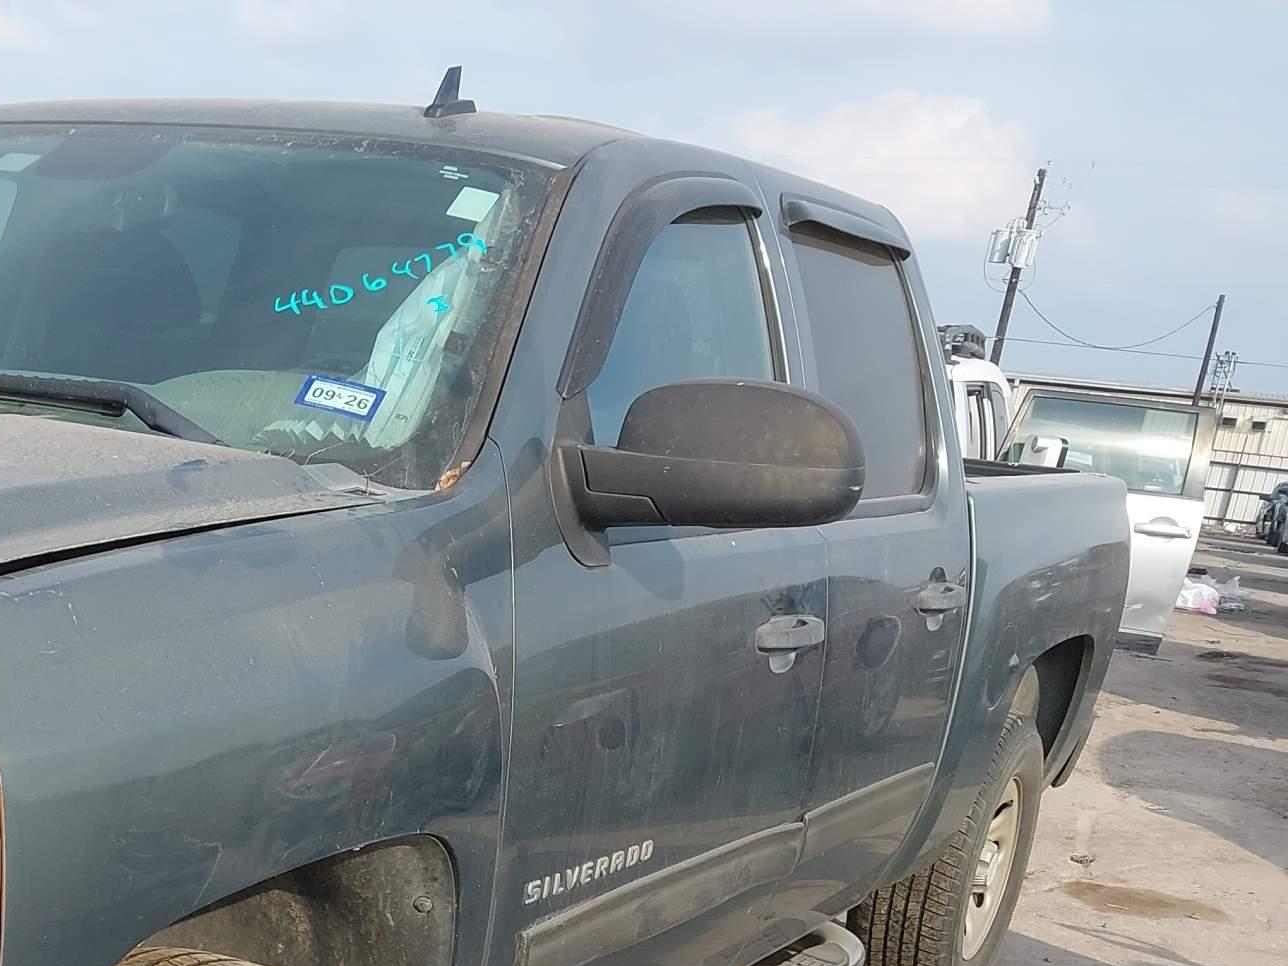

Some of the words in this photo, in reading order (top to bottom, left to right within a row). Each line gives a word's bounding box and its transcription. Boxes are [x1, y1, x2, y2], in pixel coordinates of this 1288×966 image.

[311, 387, 336, 401] 09
[344, 394, 371, 410] 26
[523, 839, 655, 905] SILVERADO
